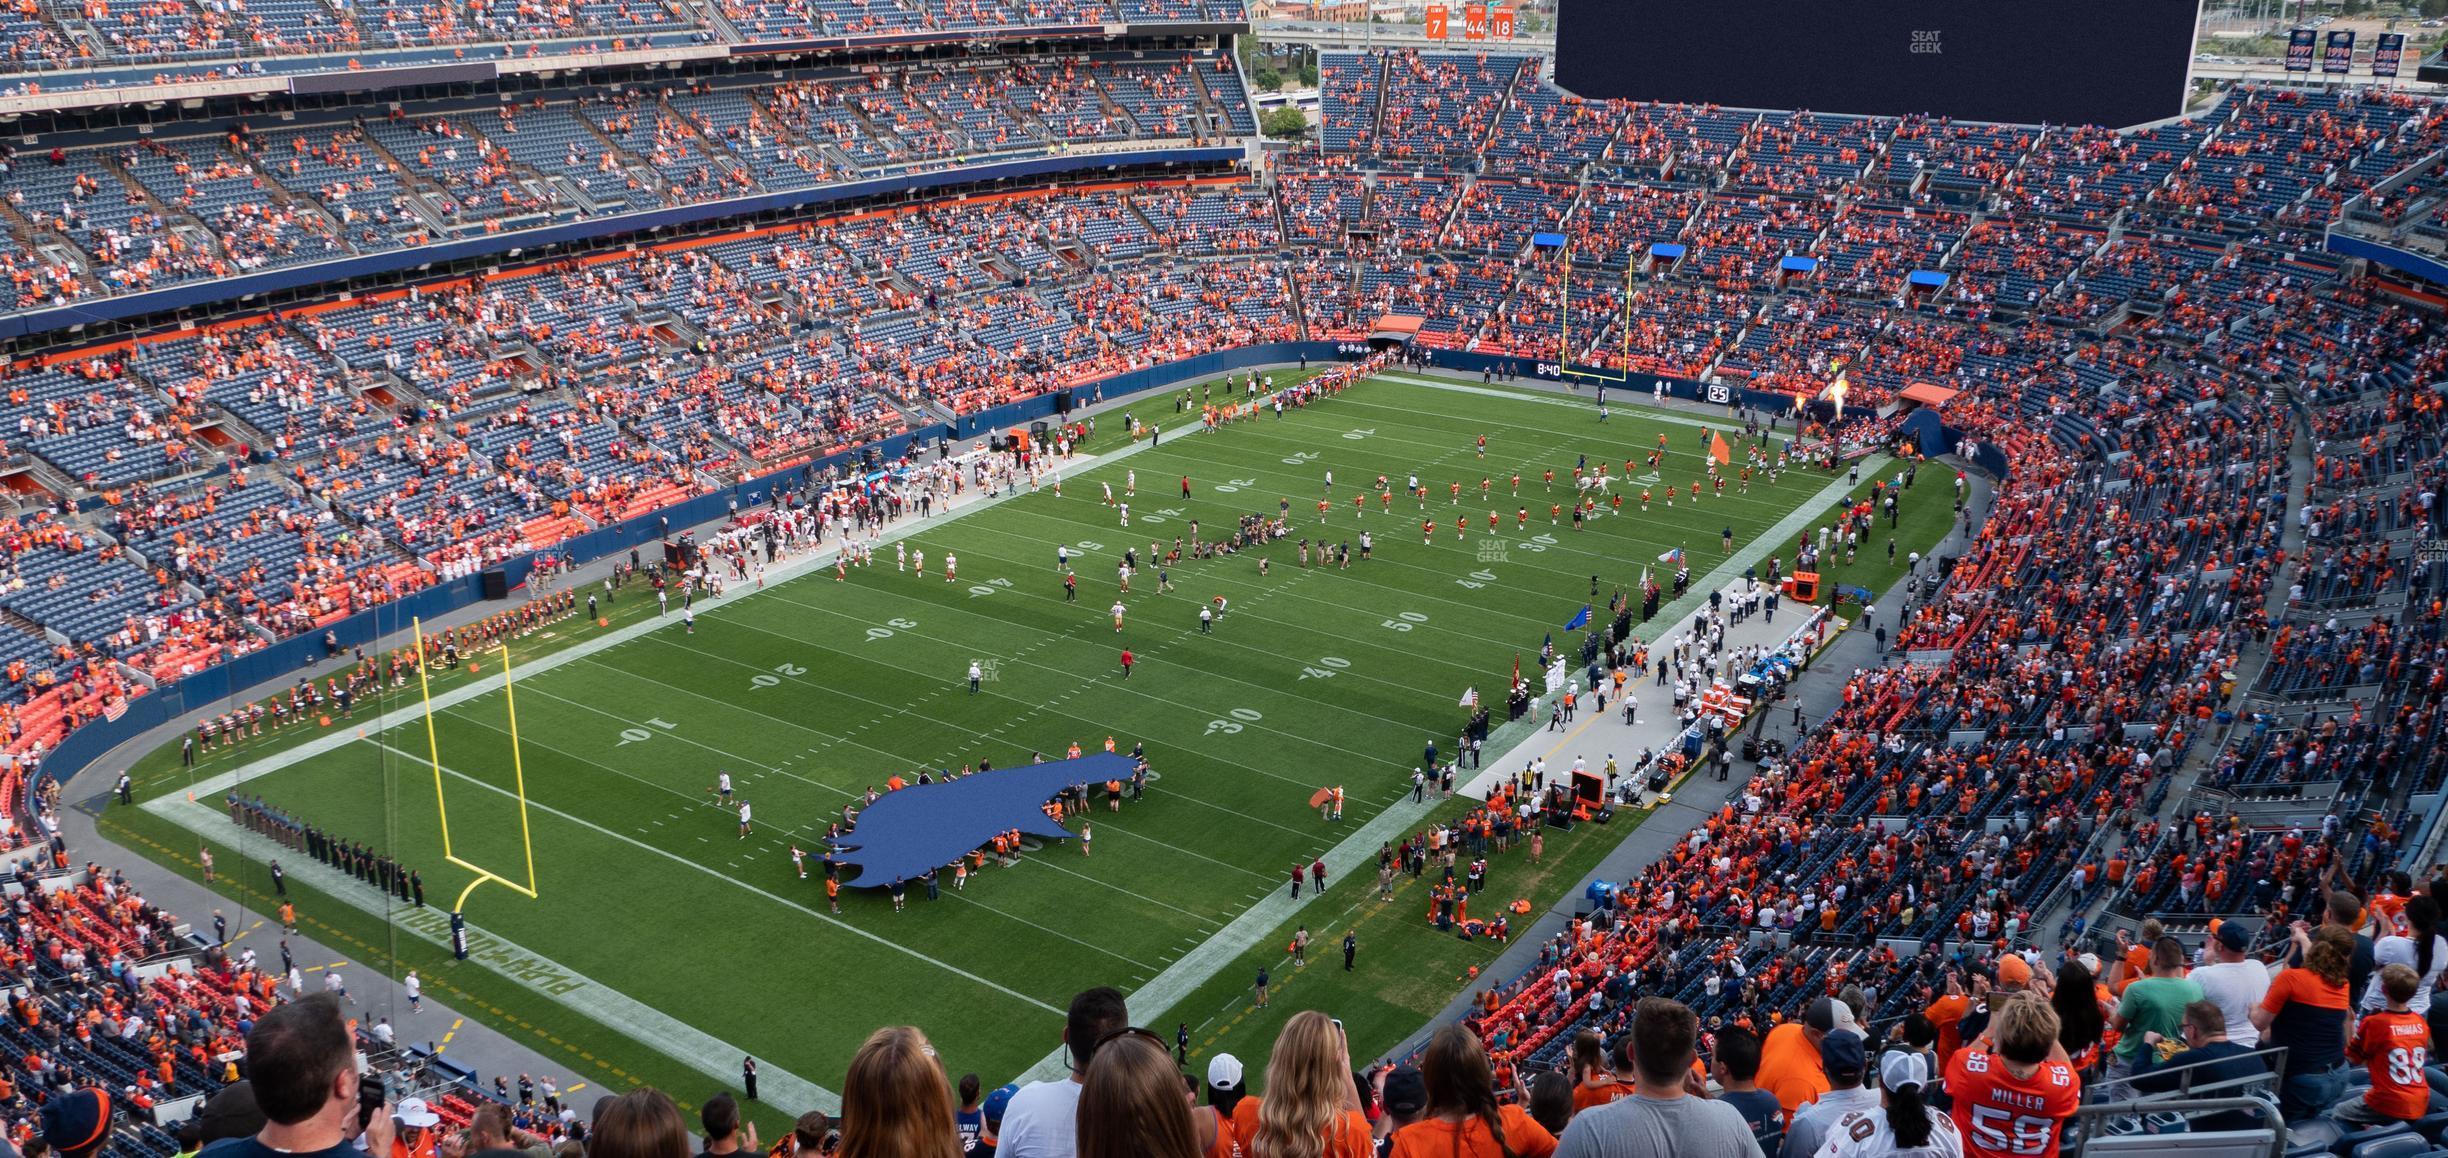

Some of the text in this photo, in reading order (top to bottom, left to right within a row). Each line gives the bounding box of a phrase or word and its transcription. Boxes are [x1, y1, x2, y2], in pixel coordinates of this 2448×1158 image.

[1432, 20, 1441, 34] 7
[1466, 21, 1485, 34] 44
[1496, 21, 1510, 35] 18
[2289, 45, 2313, 56] 1997
[2327, 47, 2351, 57] 1998
[2376, 50, 2400, 60] 2015
[1537, 363, 1560, 377] 8:40
[1711, 387, 1726, 400] 25
[1342, 429, 1375, 440] 10
[1281, 452, 1319, 465] 20
[1214, 479, 1255, 493] 30
[1518, 534, 1558, 552] 30
[968, 578, 1014, 596] 40
[1455, 571, 1497, 589] 40
[866, 618, 917, 639] 30
[1381, 612, 1428, 631] 50
[751, 663, 807, 686] 20
[1302, 656, 1351, 679] 40
[1207, 708, 1263, 735] 30
[620, 717, 678, 742] 10
[2390, 1023, 2424, 1036] THOMAS
[2387, 1047, 2426, 1086] 88
[1992, 1088, 2045, 1111] MILLER
[959, 1123, 979, 1132] LWAY
[1972, 1103, 2054, 1154] 58
